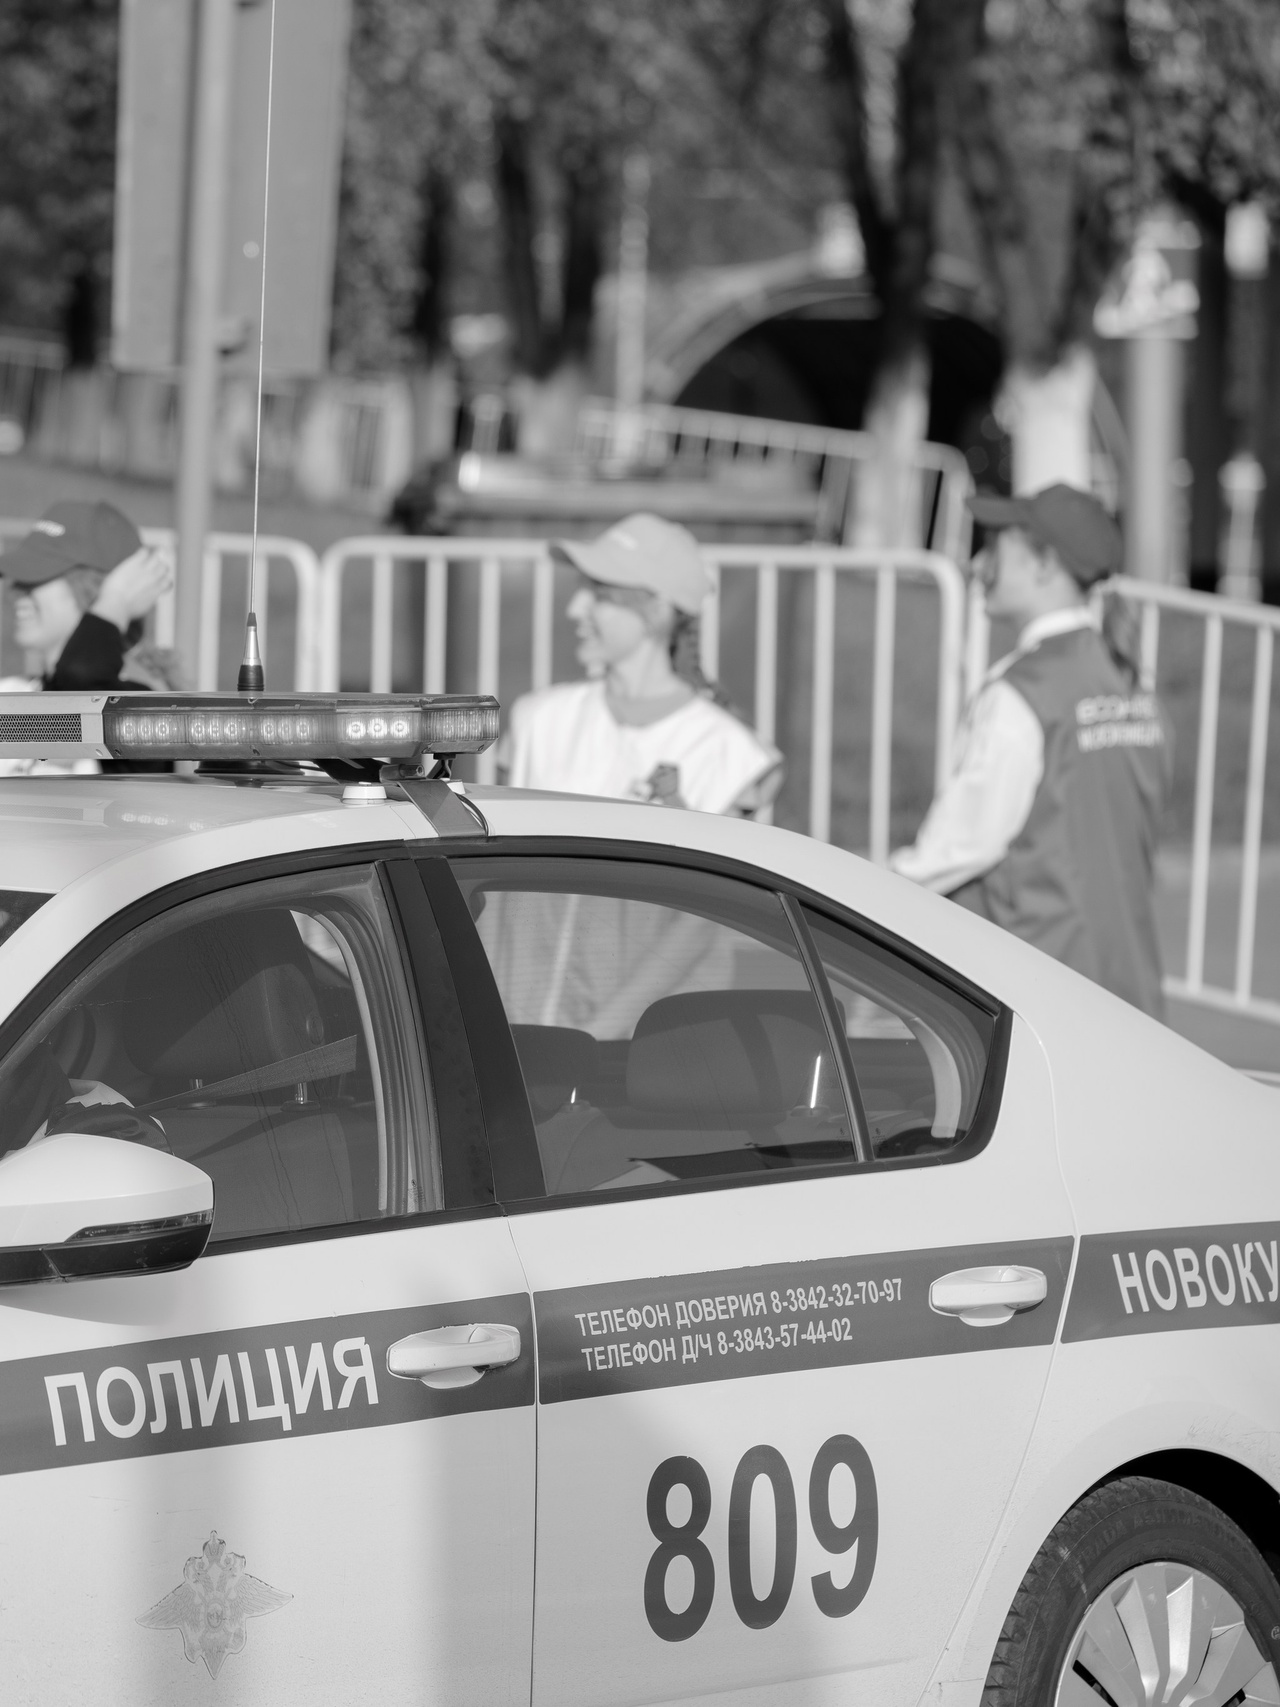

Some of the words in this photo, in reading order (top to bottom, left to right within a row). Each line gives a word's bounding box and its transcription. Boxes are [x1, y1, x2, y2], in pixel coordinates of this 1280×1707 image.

[574, 1303, 671, 1337] ТЕЛЕФОН
[674, 1292, 768, 1330] ДОВЕРИЯ
[770, 1277, 902, 1314] 8-3842-32-70-97
[1112, 1240, 1279, 1314] НОВОКУ
[581, 1337, 677, 1372] ТЕЛЕФОН
[681, 1333, 713, 1365] Д/Ч
[716, 1317, 853, 1355] 8-3843-57-44-02
[43, 1336, 379, 1447] ПОЛИЦИЯ
[643, 1433, 880, 1643] 809
